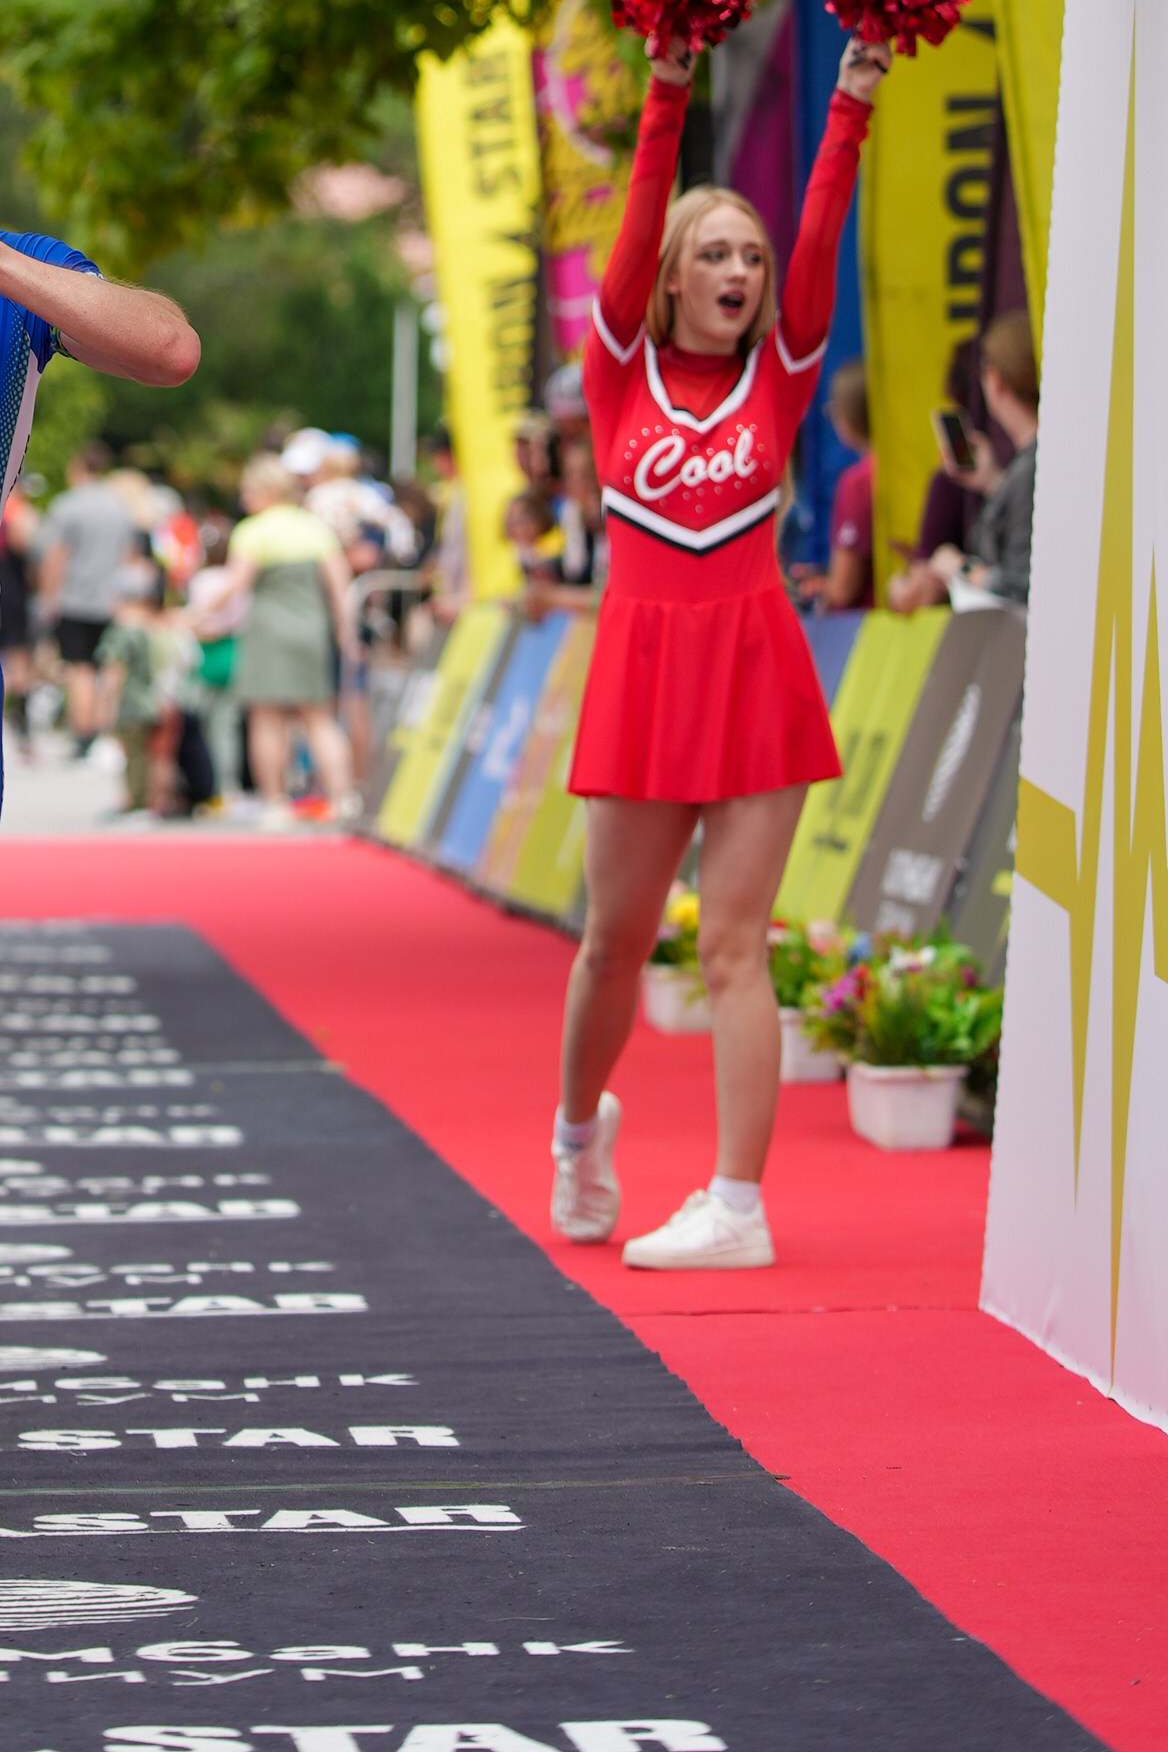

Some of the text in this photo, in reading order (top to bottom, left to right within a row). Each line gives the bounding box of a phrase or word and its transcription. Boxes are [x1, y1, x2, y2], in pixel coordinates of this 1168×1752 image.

[634, 425, 758, 501] Cool
[16, 1425, 460, 1450] STAR
[32, 1504, 522, 1530] STAR
[101, 1719, 730, 1752] STAR
